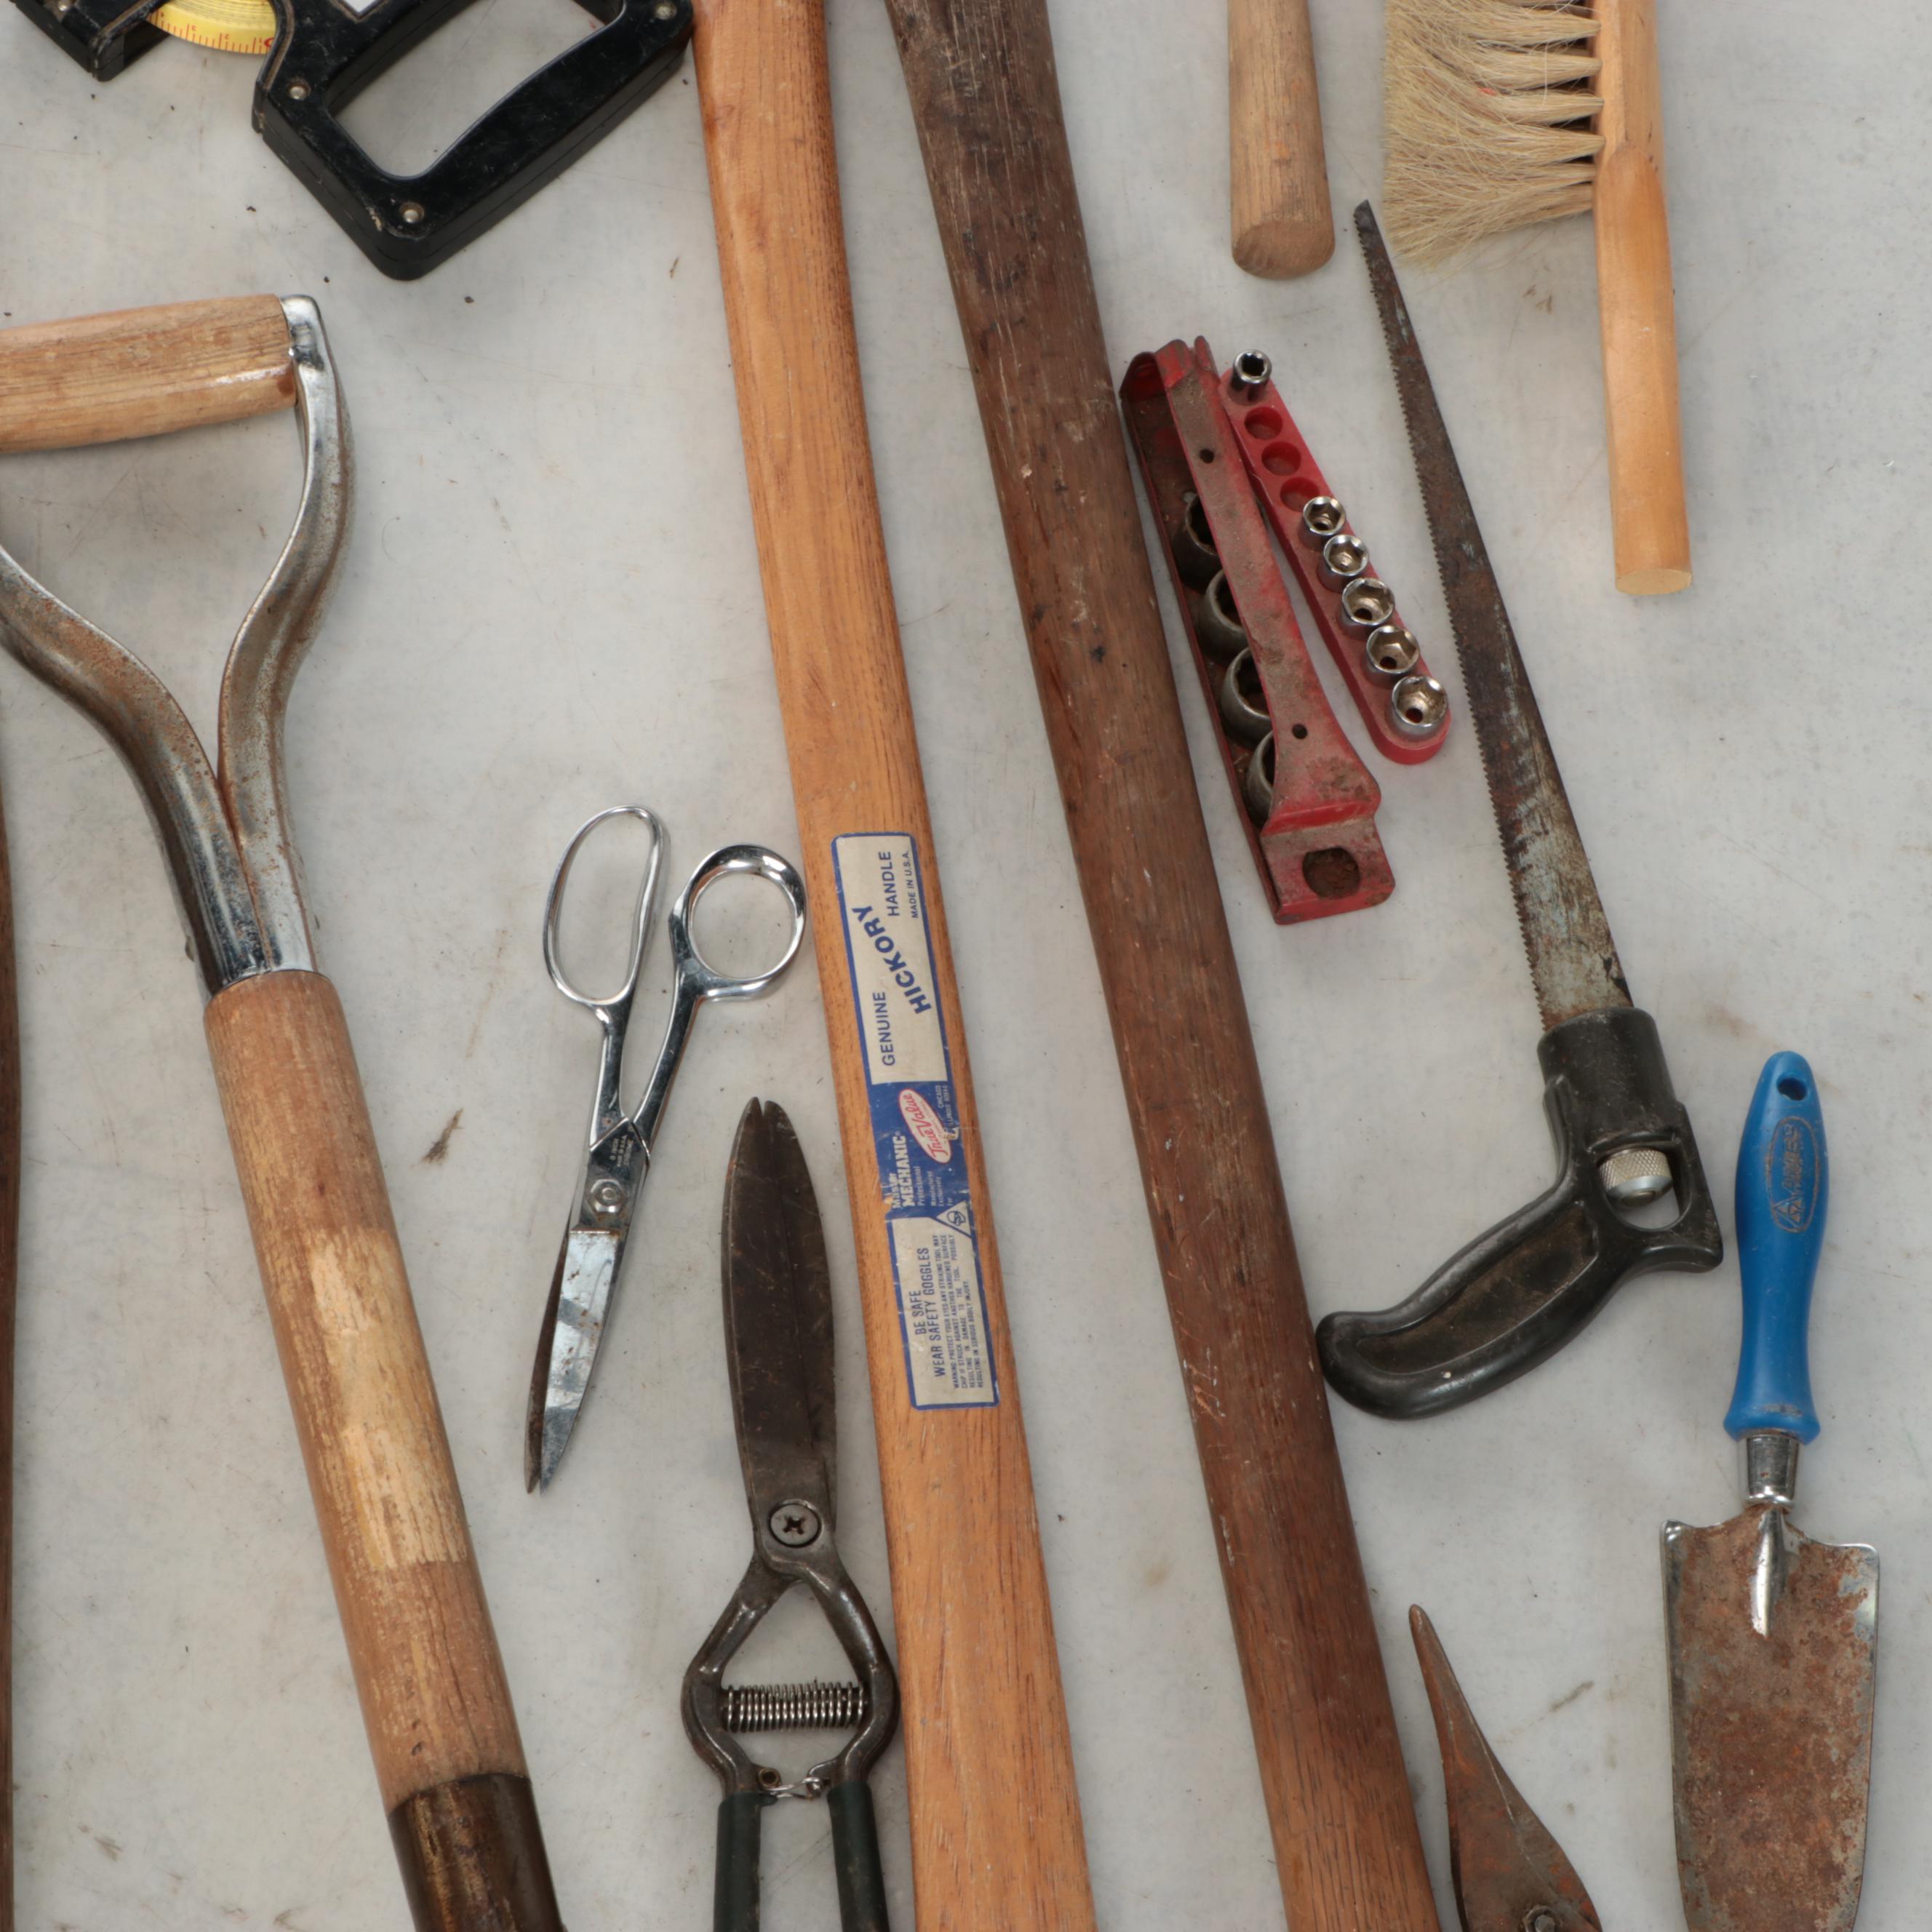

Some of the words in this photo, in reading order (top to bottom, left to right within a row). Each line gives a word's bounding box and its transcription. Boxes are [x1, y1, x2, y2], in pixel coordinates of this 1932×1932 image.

[902, 850, 912, 877] U.S.A.
[879, 851, 900, 917] HANDLE
[906, 879, 914, 889] IN
[909, 892, 919, 918] MADE
[851, 906, 932, 1014] HICKORY
[872, 991, 895, 1066] GENUINE
[935, 1085, 944, 1109] CHICAGO
[892, 1135, 916, 1207] MECHANIC
[914, 1166, 925, 1206] Professional
[940, 1234, 949, 1259] SURFACE
[948, 1234, 957, 1261] POSSIBLY
[917, 1248, 935, 1296] GOGGLES
[943, 1261, 952, 1289] HARDENED
[909, 1290, 925, 1317] SAFE
[914, 1321, 927, 1335] BE
[924, 1301, 942, 1341] SAFETY
[952, 1318, 960, 1342] AGAINST
[960, 1317, 968, 1340] DAMAGE
[946, 1335, 954, 1360] PROTECT
[969, 1325, 977, 1347] SERIOUS
[931, 1345, 946, 1377] WEAR
[956, 1344, 964, 1366] STRUCK
[966, 1357, 975, 1388] RESULTING
[974, 1357, 983, 1388] RESULTING
